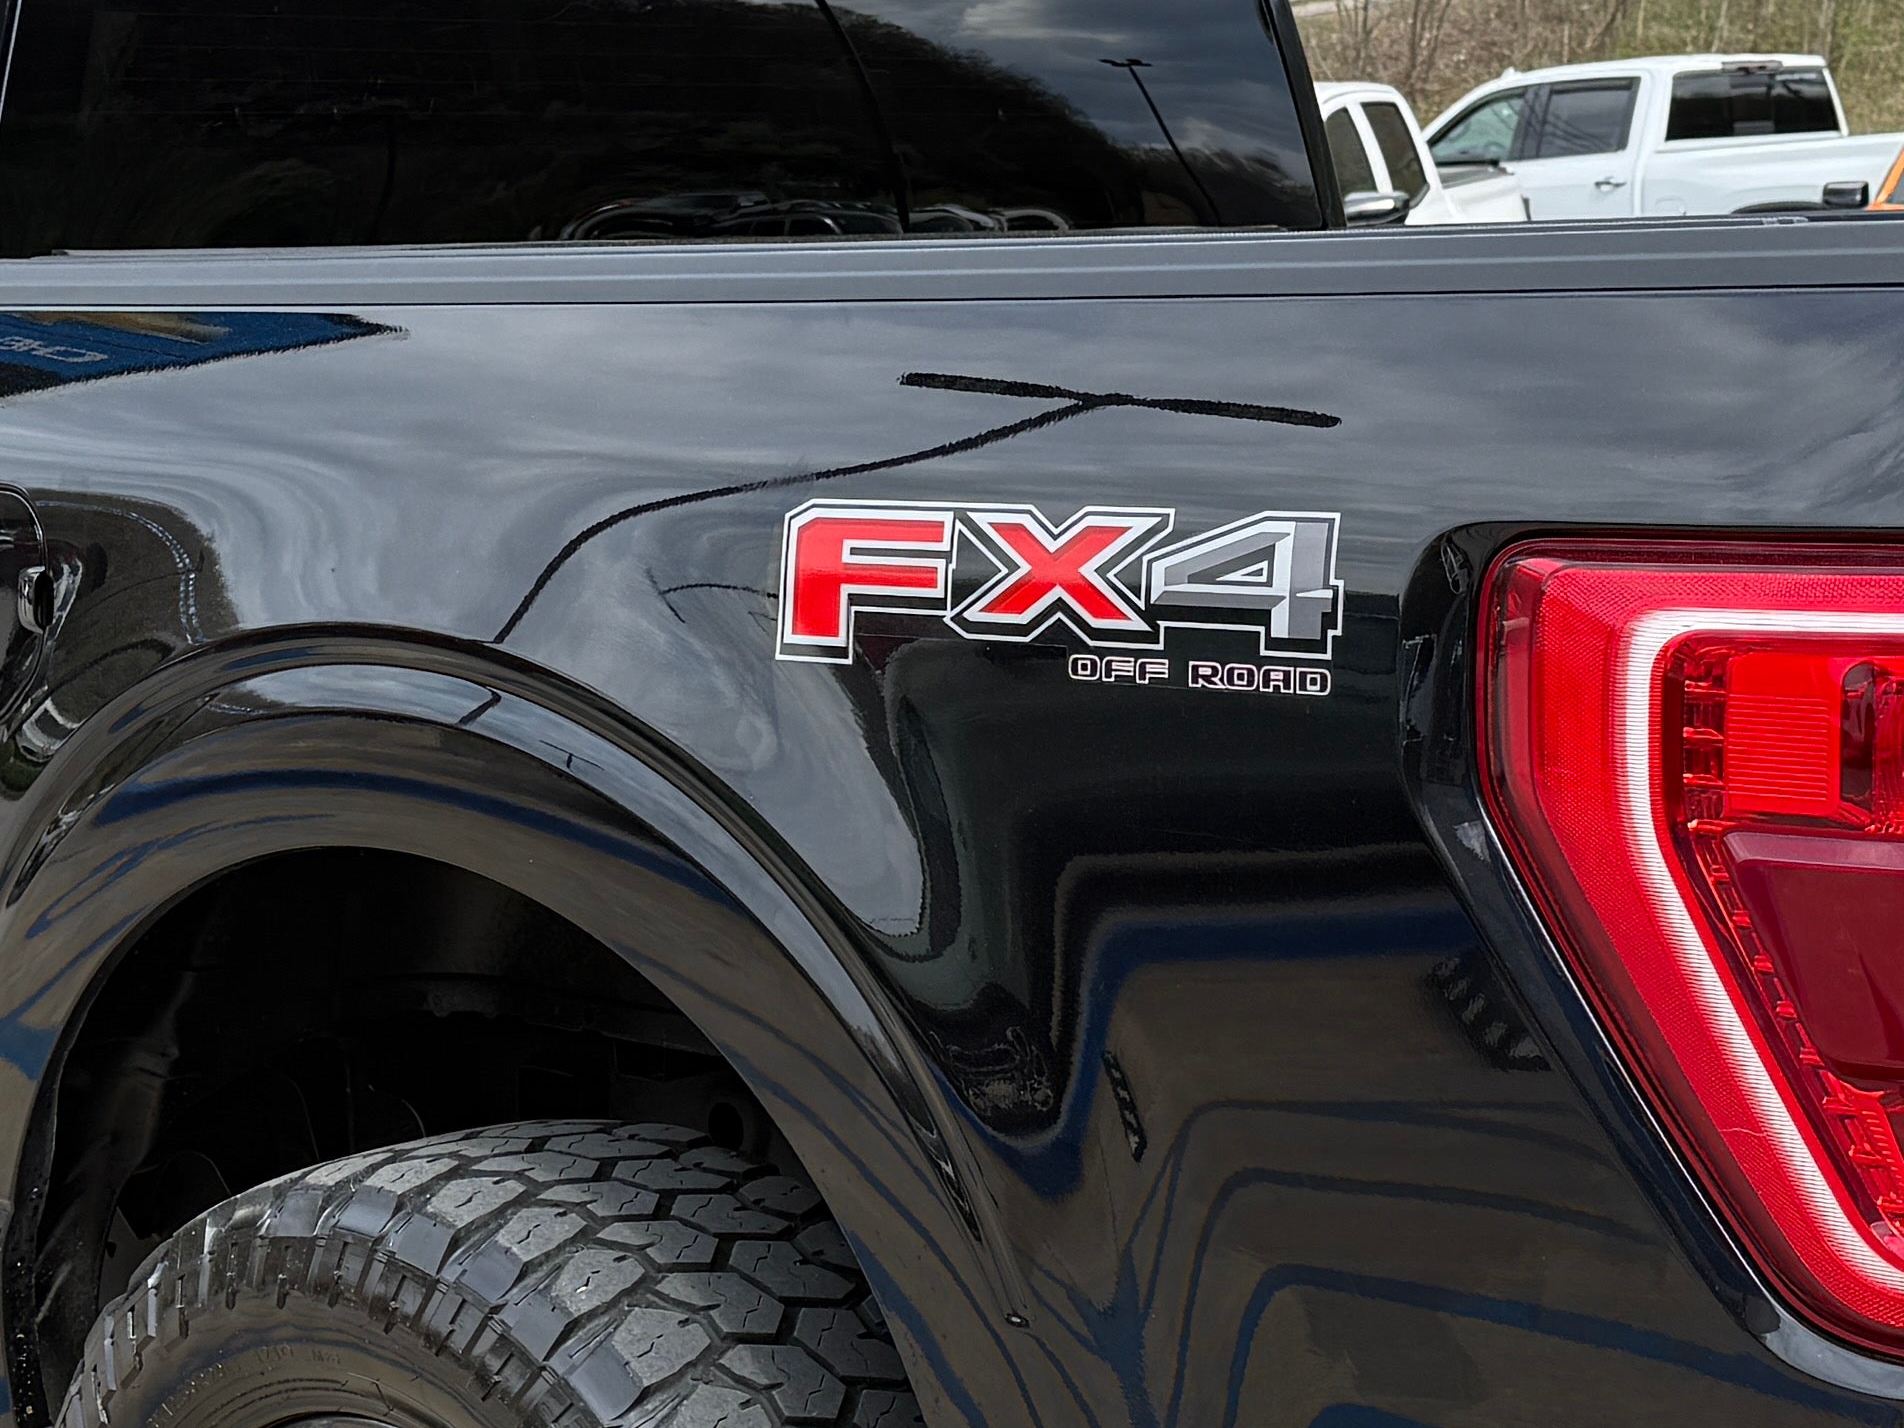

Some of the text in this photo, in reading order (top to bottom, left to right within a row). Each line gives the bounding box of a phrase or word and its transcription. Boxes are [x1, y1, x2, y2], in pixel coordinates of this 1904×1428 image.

[775, 498, 1345, 665] FX4
[1069, 654, 1332, 696] OFF ROAD
